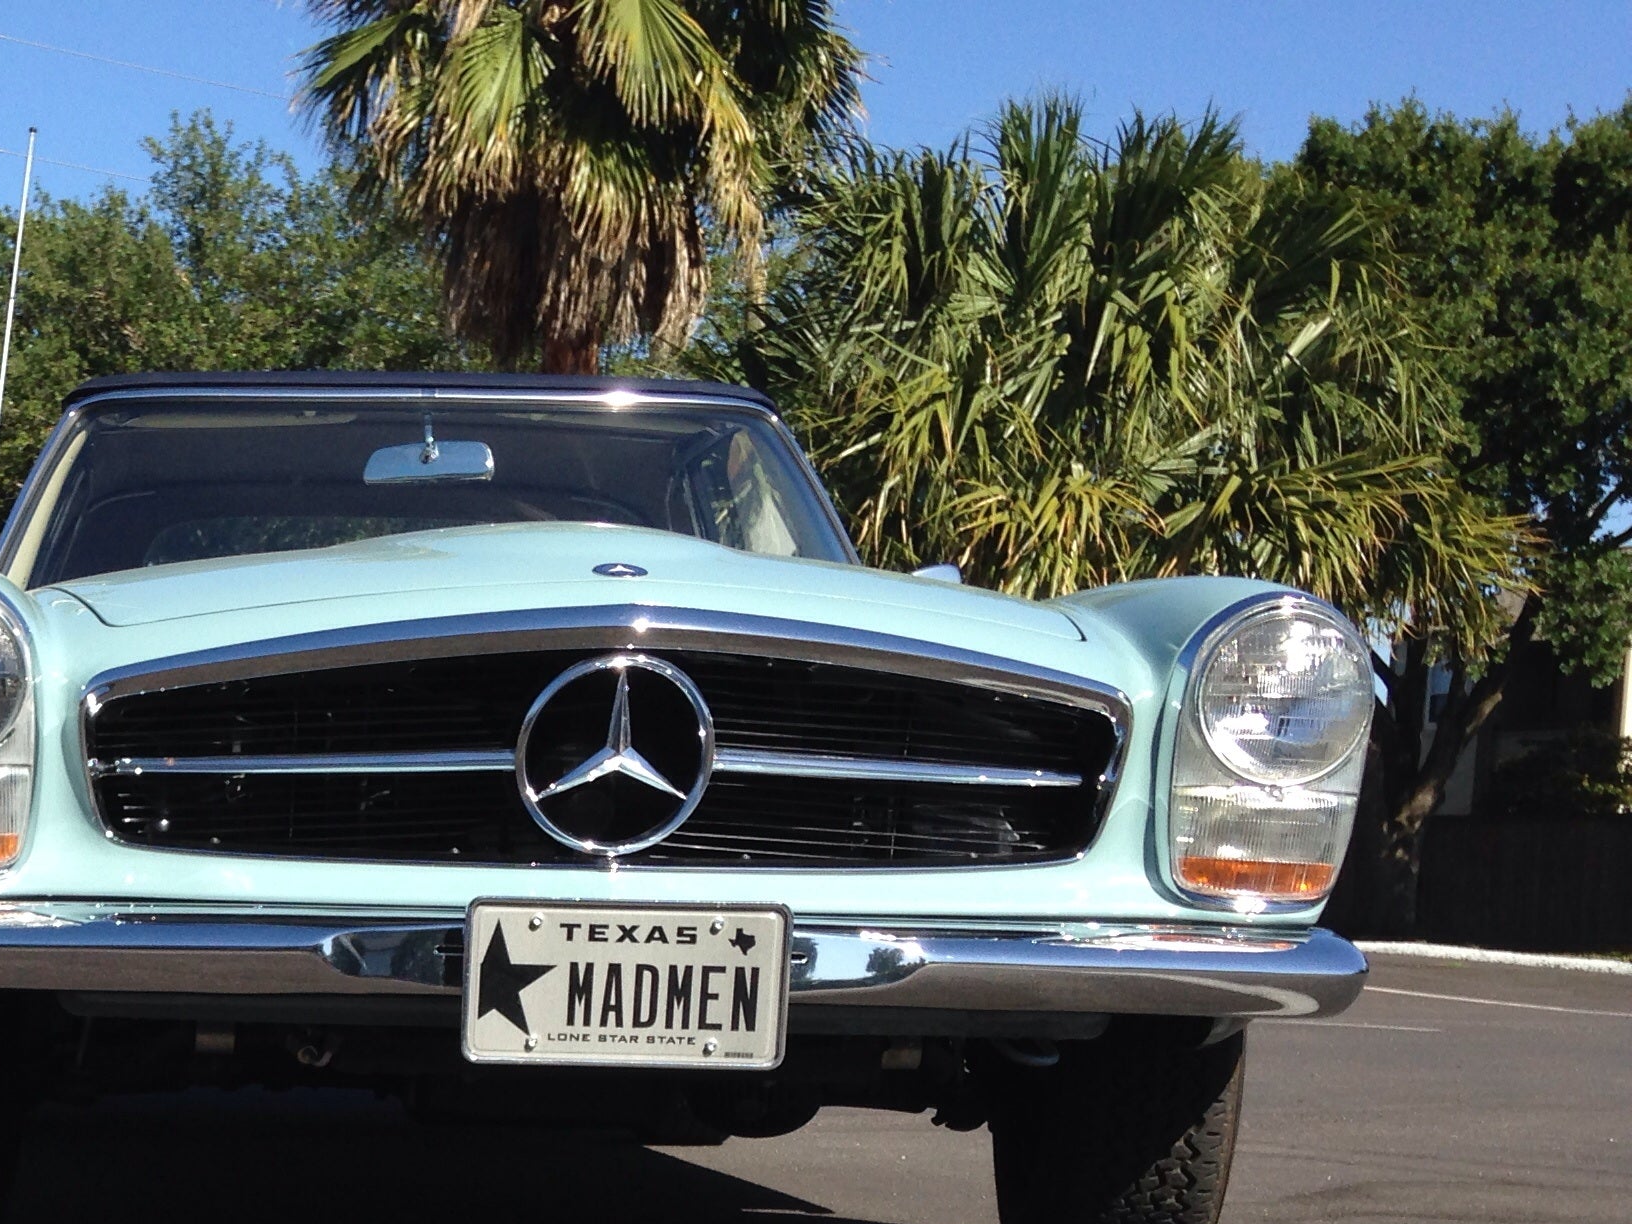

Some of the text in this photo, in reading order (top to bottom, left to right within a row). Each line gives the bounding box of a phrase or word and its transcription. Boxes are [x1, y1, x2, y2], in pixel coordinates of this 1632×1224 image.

[560, 923, 698, 944] TEXAS
[566, 961, 760, 1032] MADMEN
[548, 1033, 696, 1045] LONE STAR STATE
